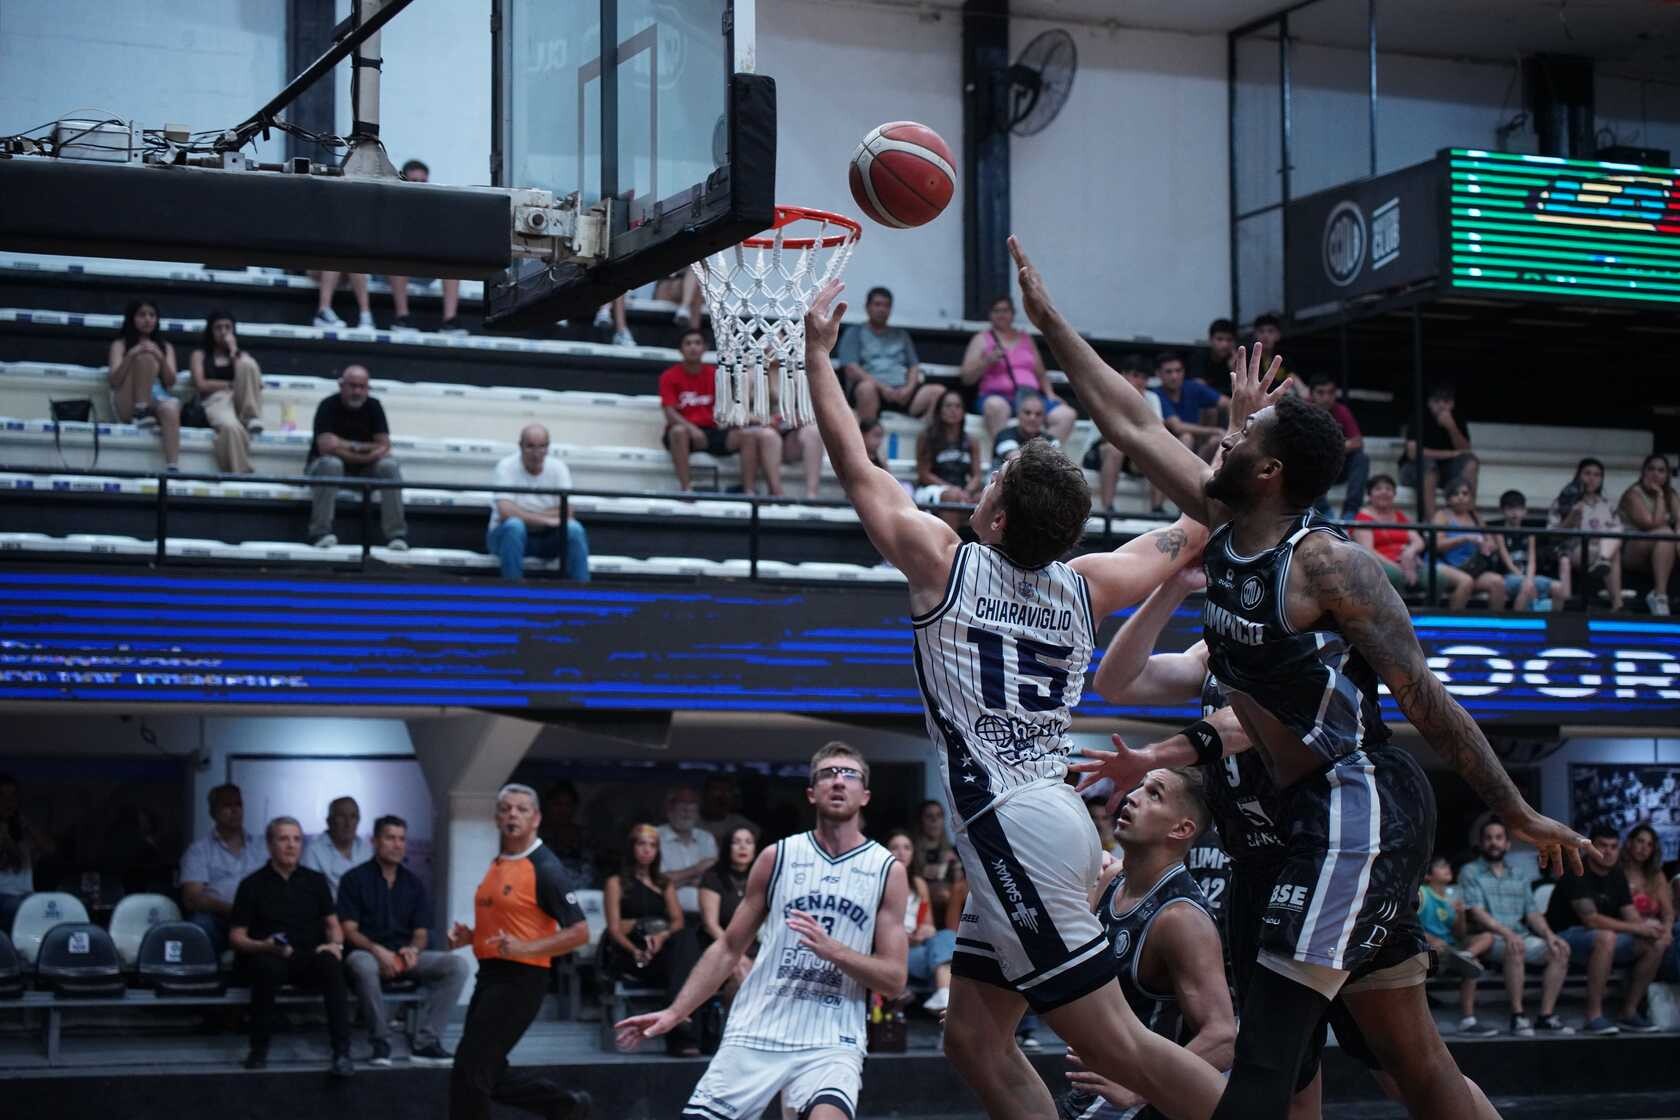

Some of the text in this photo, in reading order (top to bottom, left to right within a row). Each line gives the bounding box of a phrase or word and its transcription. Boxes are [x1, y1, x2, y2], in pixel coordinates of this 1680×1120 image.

[975, 596, 1072, 632] CHIARAVIGLIO
[966, 627, 1075, 712] 15
[1378, 645, 1680, 698] OGR
[991, 858, 1023, 903] SAMAK
[1201, 877, 1226, 909] 12
[1270, 884, 1308, 908] BSE
[783, 890, 869, 932] PEÑAROL
